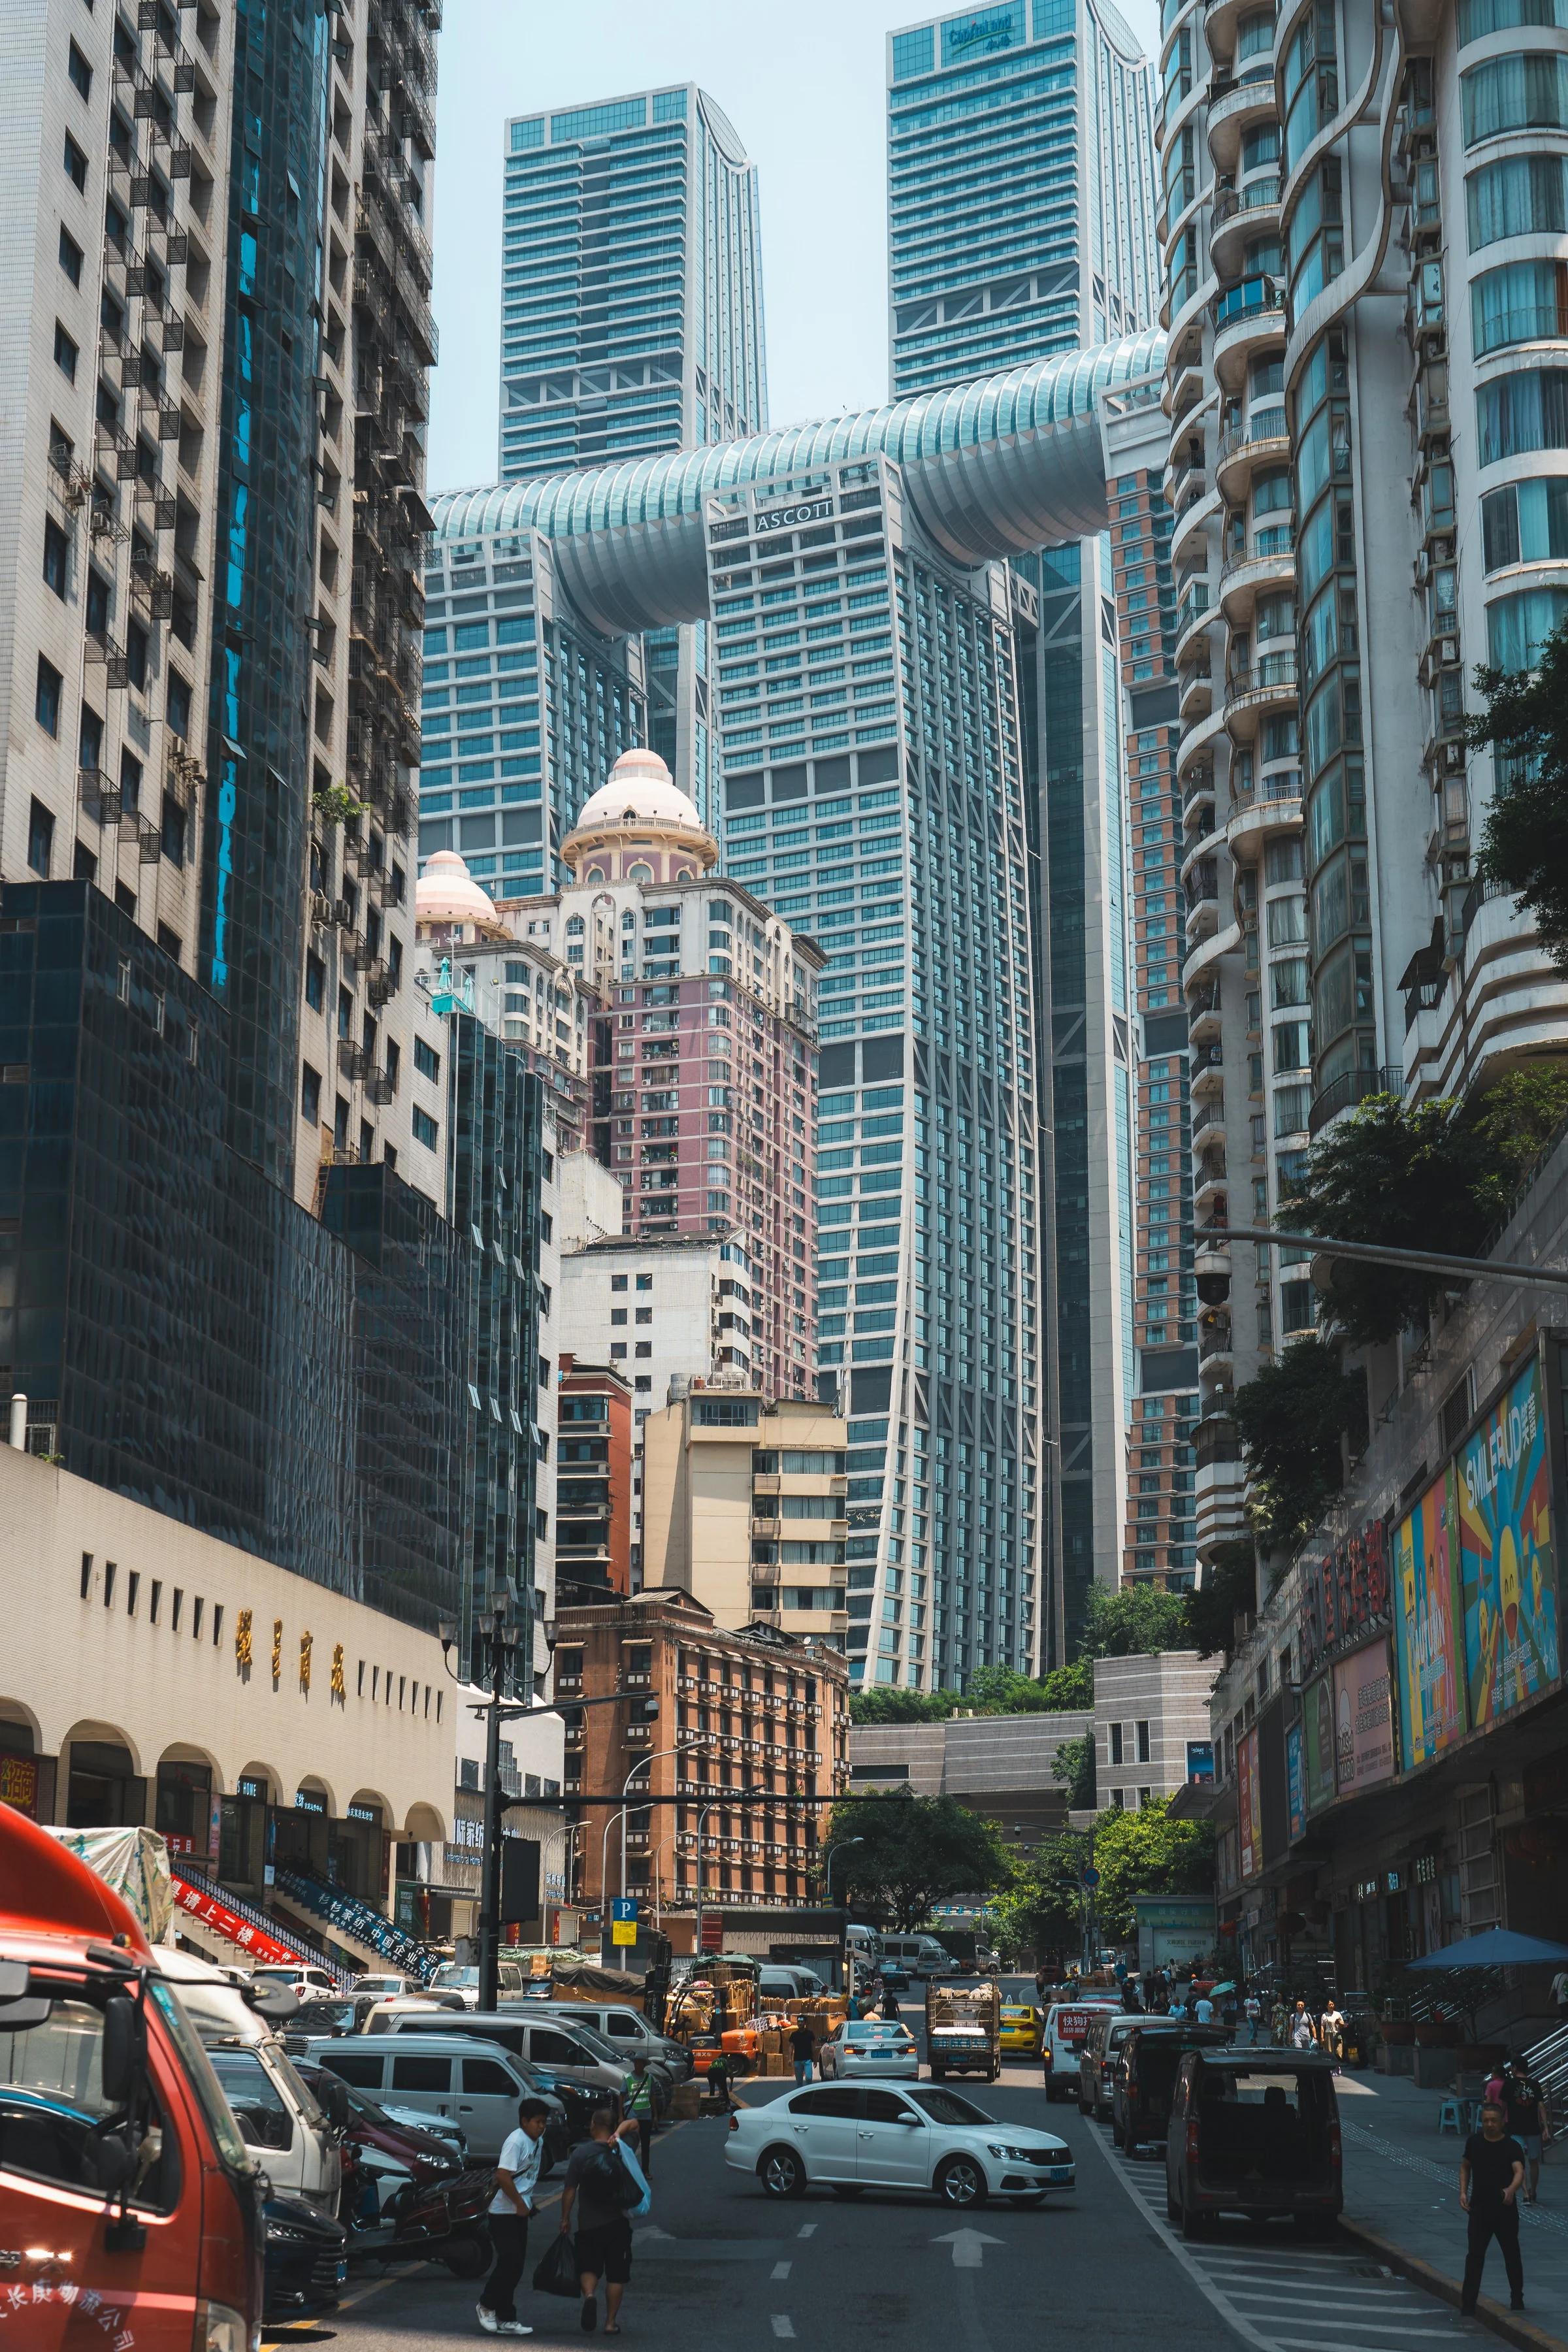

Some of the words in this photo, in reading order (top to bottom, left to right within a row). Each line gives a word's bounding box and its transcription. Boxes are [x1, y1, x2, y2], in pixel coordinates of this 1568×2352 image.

[757, 500, 832, 531] ASCOTT
[1339, 1731, 1354, 1757] MASHI
[1339, 1756, 1354, 1784] MARO
[243, 1782, 256, 1797] HOME
[318, 1893, 367, 1929] 杉杉家纺
[621, 1903, 630, 1918] P
[0, 2278, 135, 2352] 长庚物流公司
